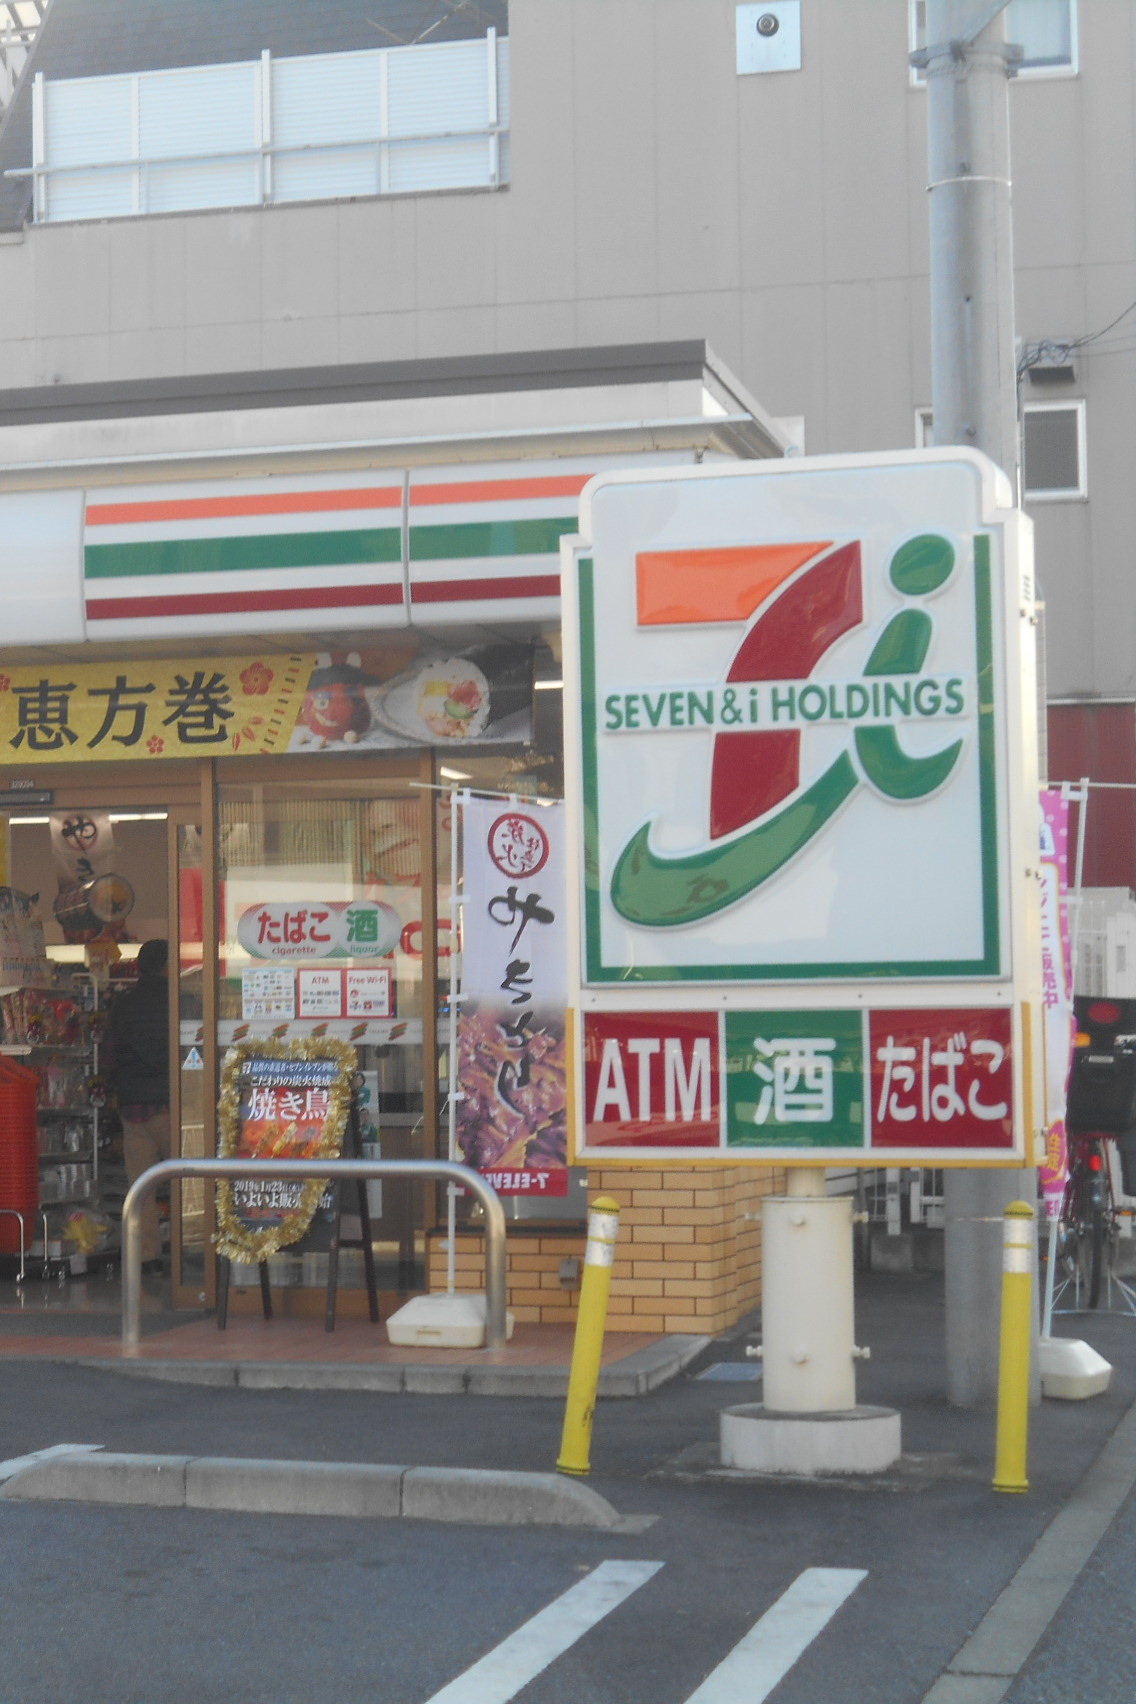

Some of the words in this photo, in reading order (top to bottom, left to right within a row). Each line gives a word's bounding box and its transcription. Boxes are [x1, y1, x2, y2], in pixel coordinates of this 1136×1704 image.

[10, 671, 236, 752] 恵方巻
[772, 677, 965, 722] HOLDINGS
[258, 909, 331, 943] たばこ
[347, 909, 379, 942] 酒
[272, 946, 317, 956] cigarette
[350, 945, 380, 955] liquor
[311, 976, 330, 984] ATM
[349, 976, 365, 984] Free
[367, 976, 387, 984] Wi-Fi
[592, 1036, 713, 1123] ATM
[753, 1037, 836, 1125] 酒
[876, 1032, 1008, 1124] たばこ
[248, 1086, 331, 1121] 焼き鳥
